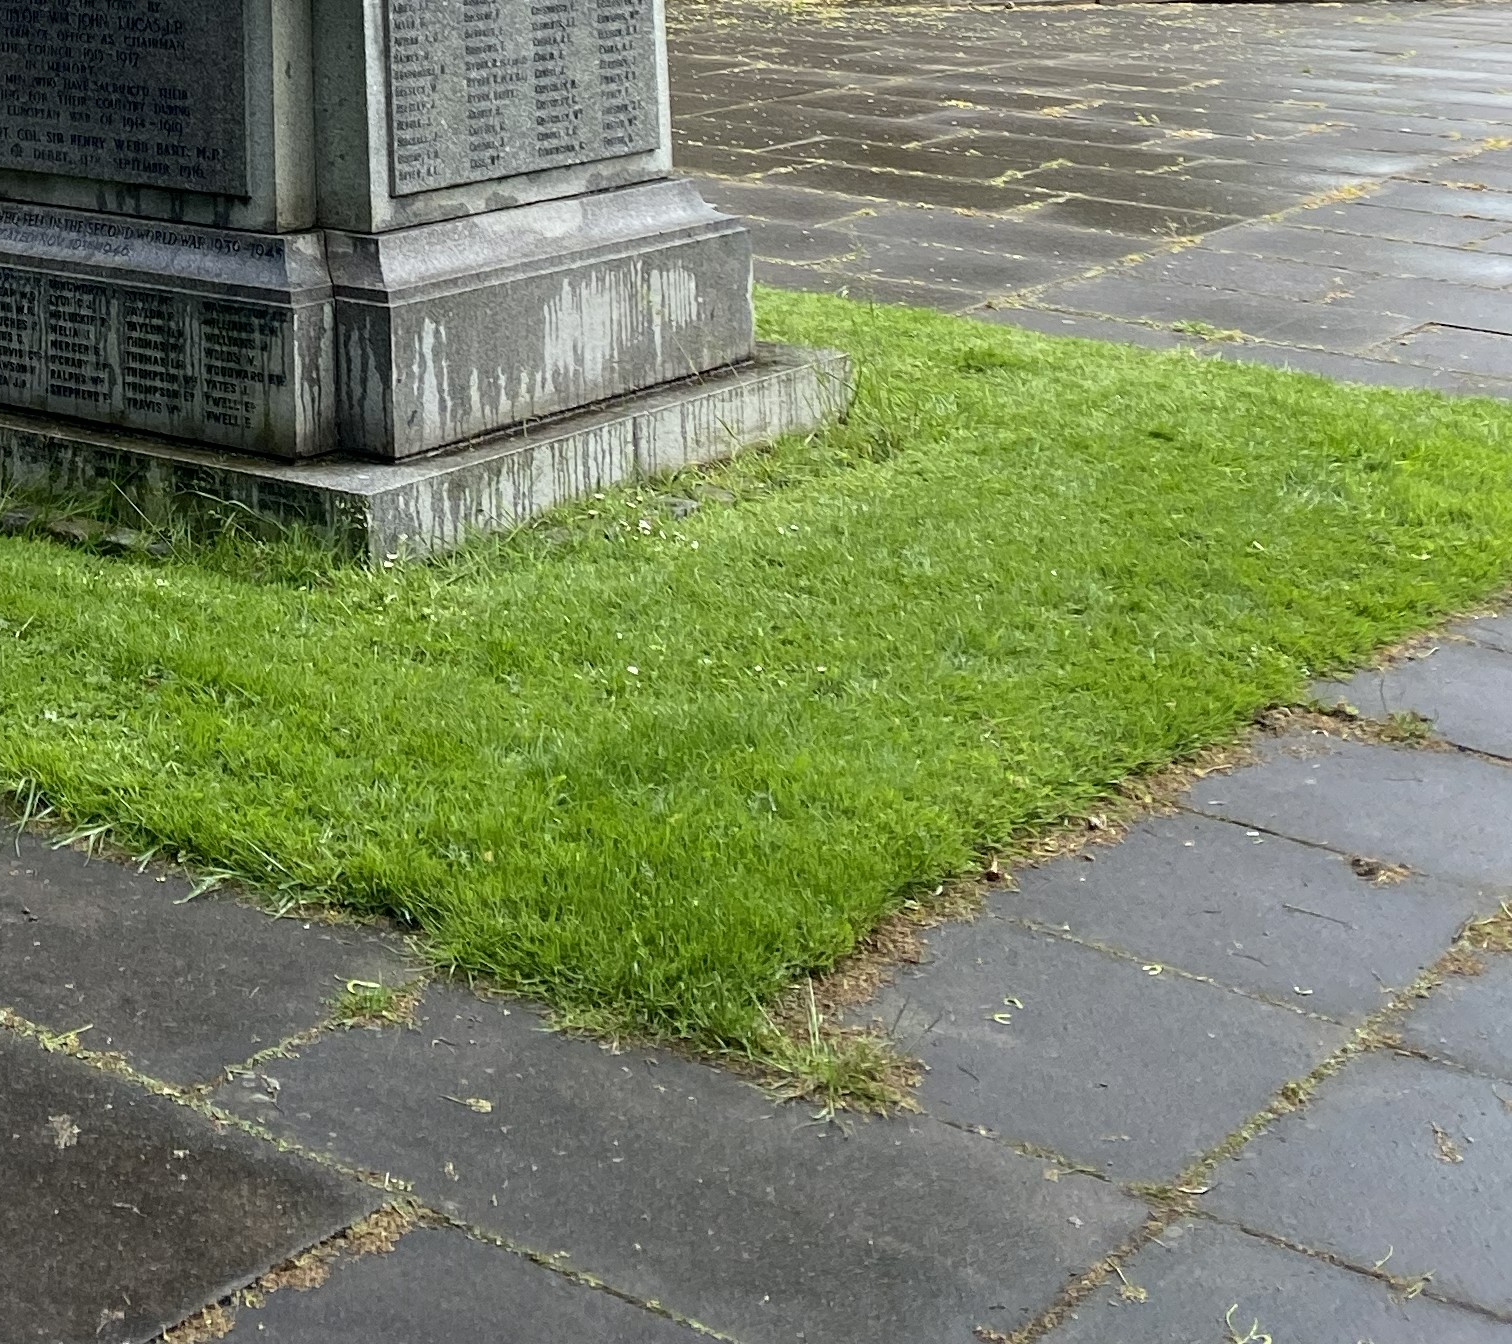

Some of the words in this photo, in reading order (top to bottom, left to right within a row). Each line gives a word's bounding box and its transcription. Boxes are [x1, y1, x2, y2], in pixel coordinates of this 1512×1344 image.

[64, 218, 84, 233] THE
[85, 221, 134, 240] SECOND
[136, 228, 178, 247] WORLD
[180, 234, 206, 250] WAR
[204, 377, 237, 394] YATES
